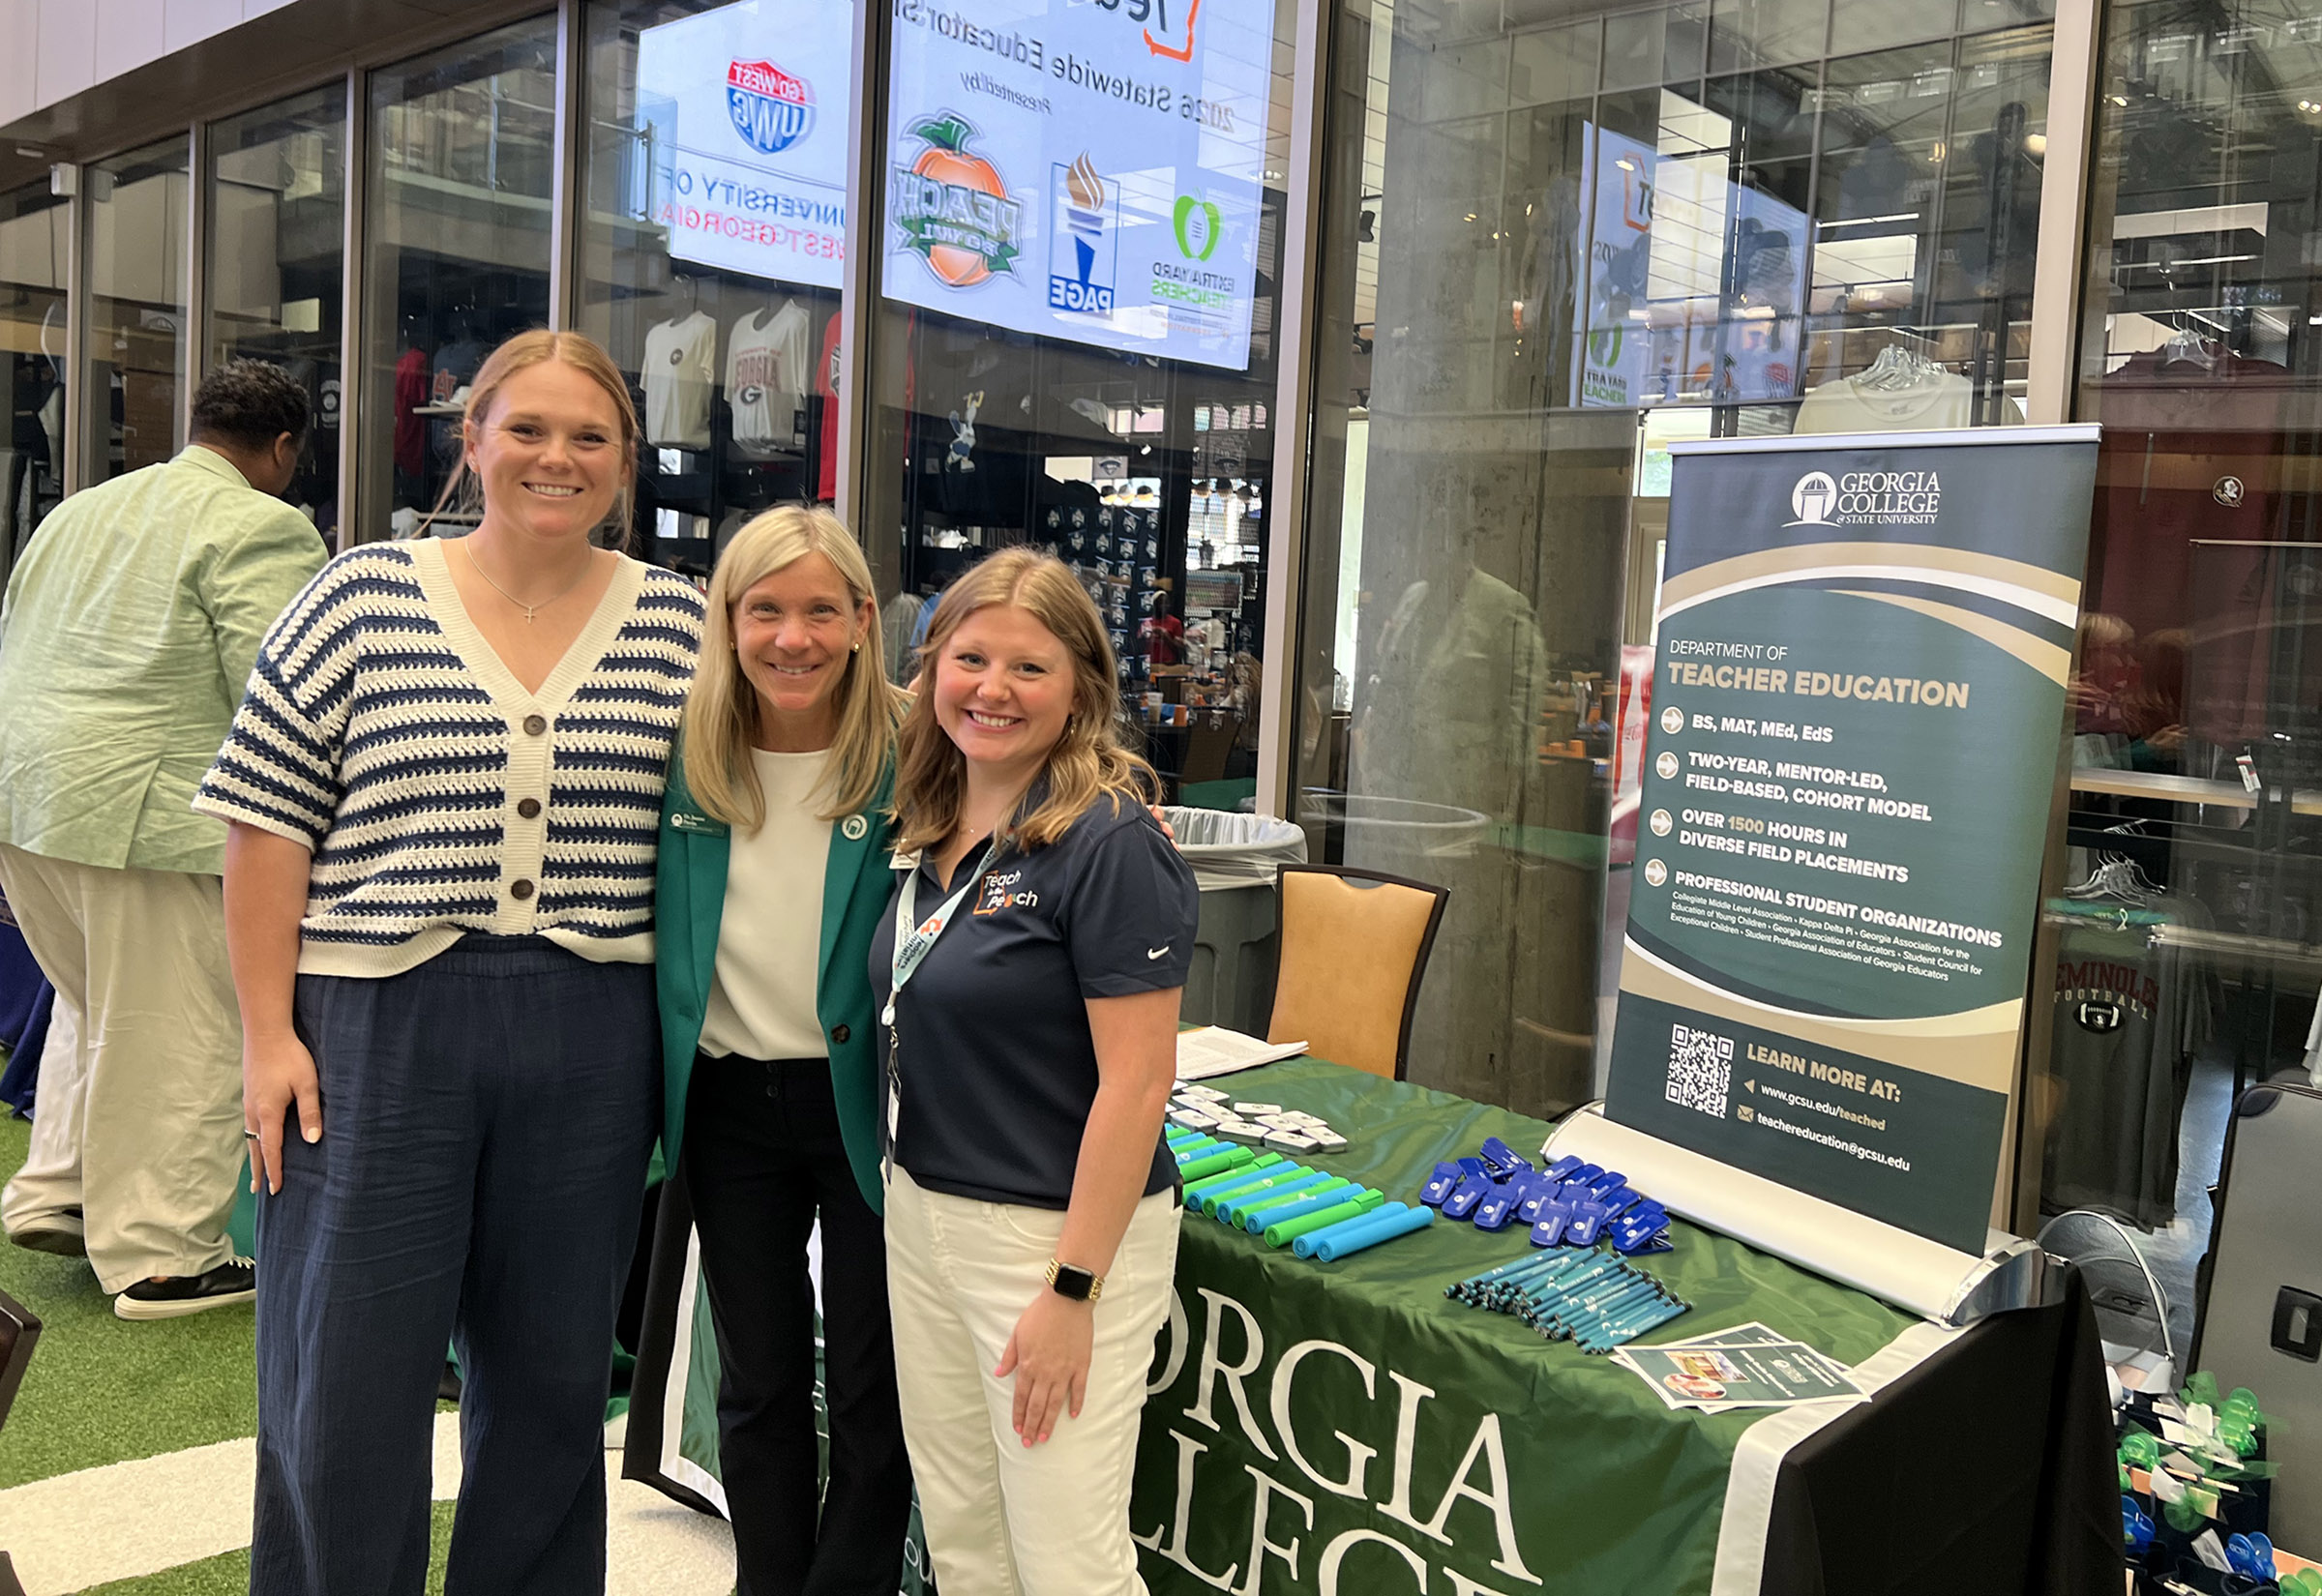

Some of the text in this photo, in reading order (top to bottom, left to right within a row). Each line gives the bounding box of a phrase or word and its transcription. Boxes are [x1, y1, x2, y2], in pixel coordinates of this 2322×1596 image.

[1837, 492, 1940, 515] COLLEGE
[1841, 471, 1941, 493] GEORGIA
[1845, 515, 1876, 524] STATE
[1878, 514, 1938, 524] UNIVERSITY
[1669, 639, 1788, 662] DEPARTMENT OF
[1668, 662, 1970, 709] TEACHER EDUCATION
[1692, 715, 1834, 743] BS, MAT, MEd, EdS
[1688, 752, 1889, 793] TWO-YEAR, MENTOR-LED,
[1685, 775, 1933, 822] FIELD-BASED, COHORT MODEL
[1682, 809, 1848, 849] OVER 1500 HOURS IN
[984, 870, 1023, 889] Teach
[1680, 830, 1910, 883] DIVERSE FIELD PLACEMENTS
[986, 890, 1039, 909] Pech
[1675, 871, 2003, 949] PROFESSIONAL STUDENT ORGANIZATIONS
[1670, 912, 1950, 982] Exceptional Children Student Professional Association of Georgia Educators
[1671, 901, 1982, 976] Education of Young Children Georgia Association of Educators Student Council for
[1672, 890, 1971, 960] Collegiate Middle Level Association Kappa Delta Pi Georgia Association for the
[2053, 988, 2148, 1020] FOOTBALL
[2055, 961, 2160, 1014] EMINOLE
[1746, 1043, 1902, 1103] LEARN MORE AT:
[1760, 1083, 1887, 1132] www.gcsu.edu/teached
[1757, 1111, 1911, 1171] teachereducation@gcsu.edu
